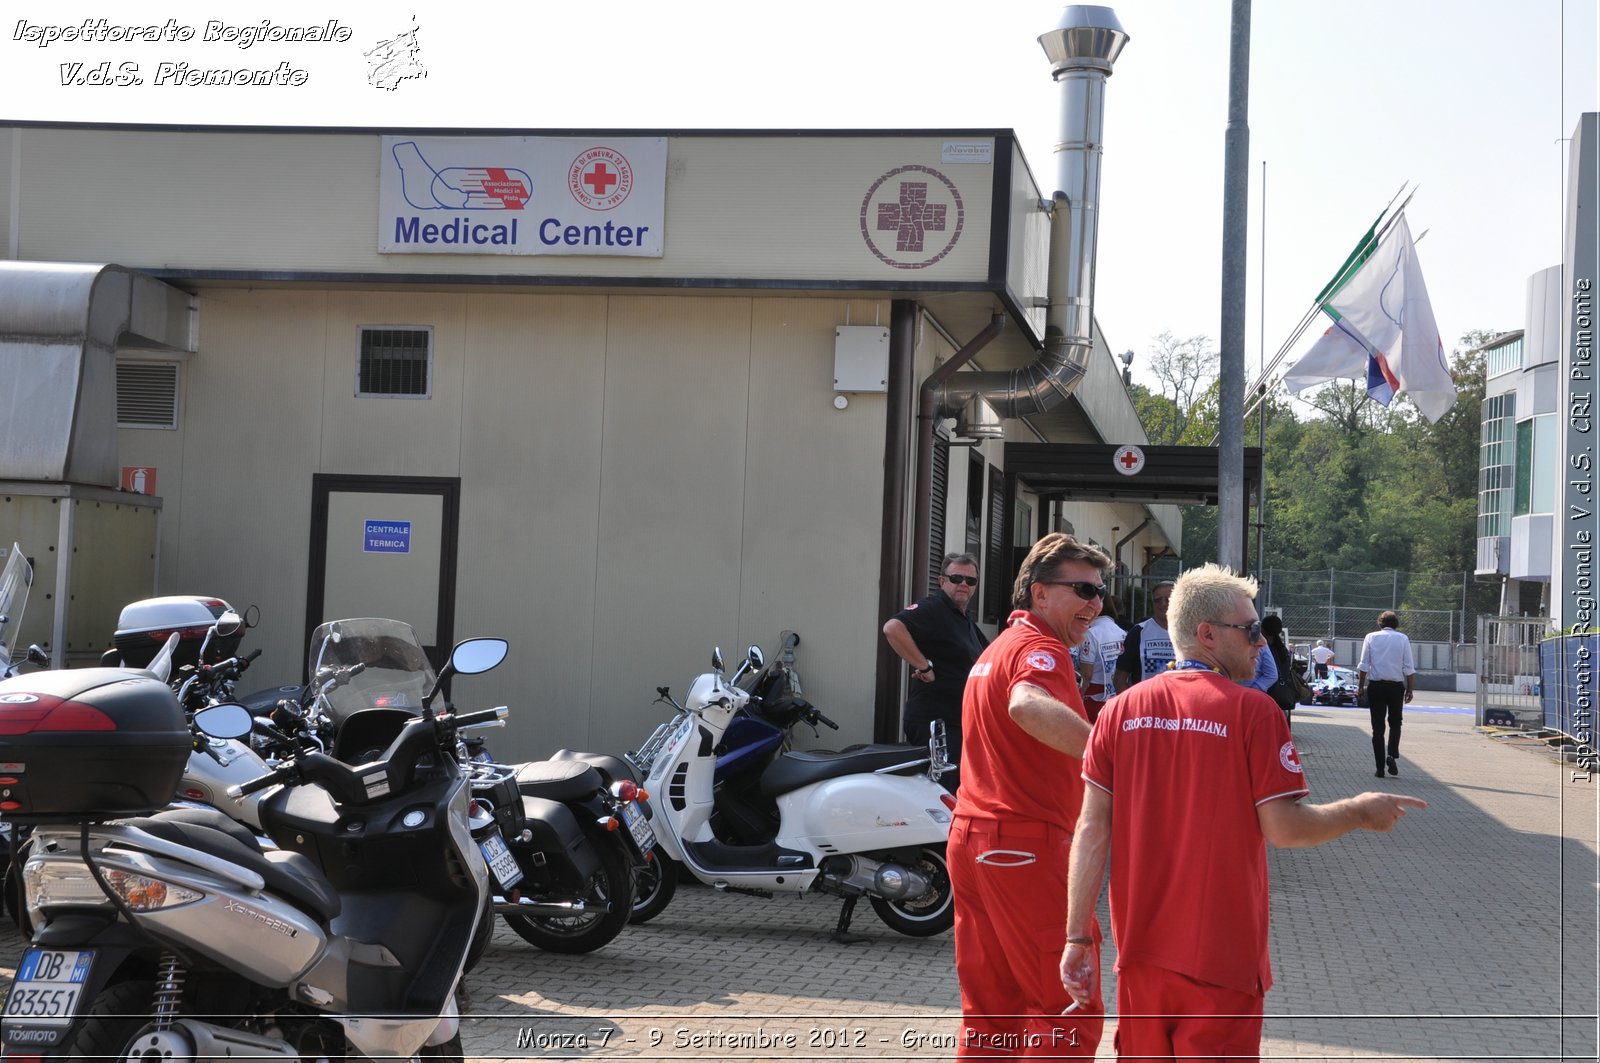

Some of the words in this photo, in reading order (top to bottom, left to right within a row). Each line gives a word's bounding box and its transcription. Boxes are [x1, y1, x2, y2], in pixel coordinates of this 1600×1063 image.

[586, 150, 614, 160] GINEVRA
[621, 166, 630, 193] AGOSTO
[484, 180, 522, 188] Associazione
[494, 187, 514, 195] Medici
[395, 216, 518, 246] Medical
[539, 217, 649, 247] Center
[367, 525, 409, 534] CENTRALE
[369, 539, 405, 548] TERMICA
[1122, 716, 1153, 732] CROCE
[1181, 718, 1228, 738] ITALIANA
[491, 854, 517, 881] 76699
[34, 952, 65, 980] DB
[71, 967, 86, 982] MI
[8, 989, 76, 1017] 83551
